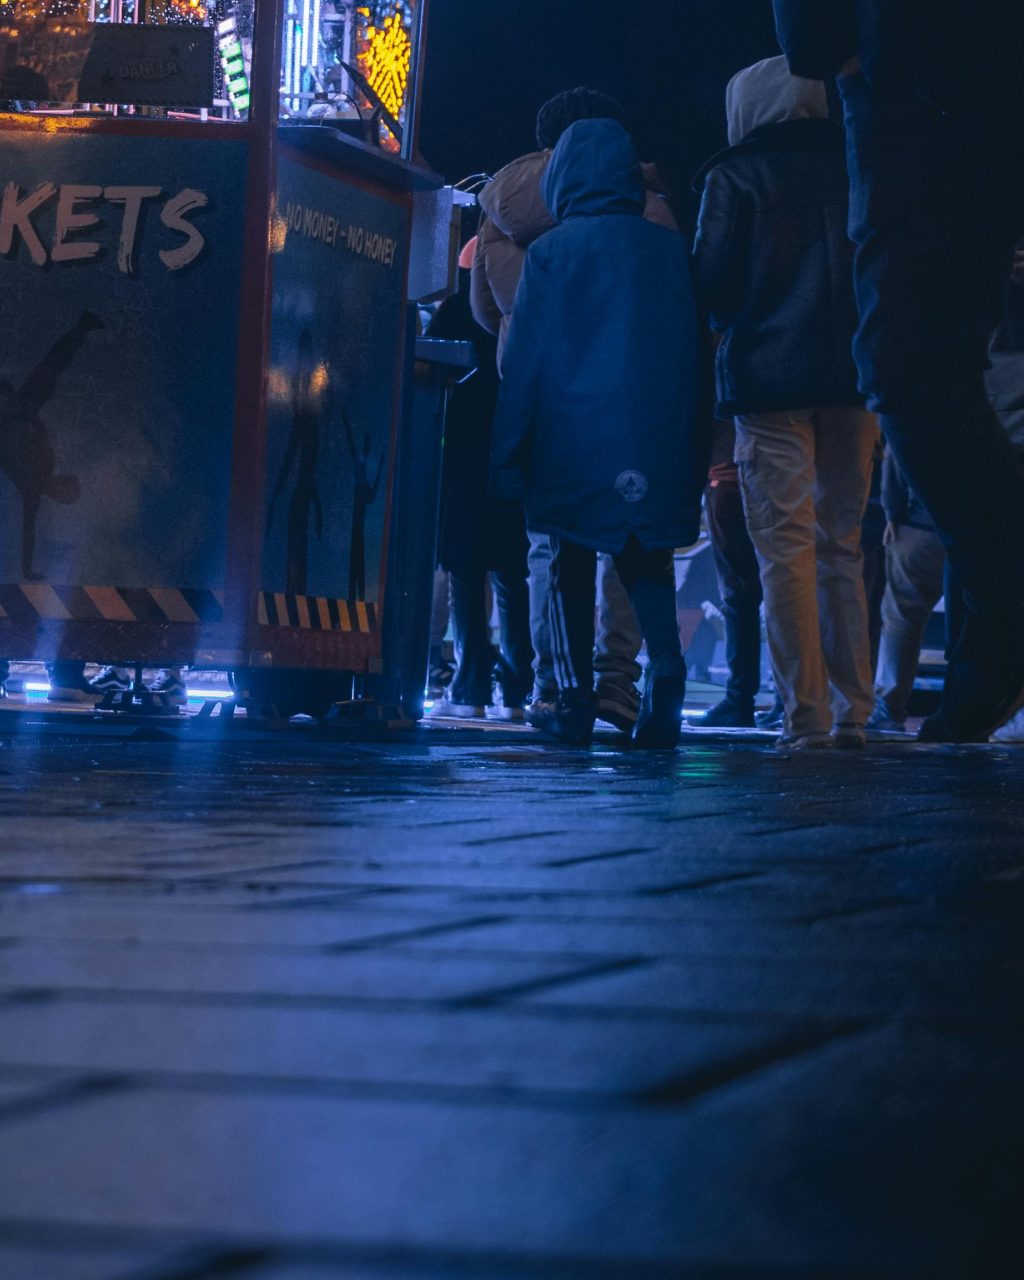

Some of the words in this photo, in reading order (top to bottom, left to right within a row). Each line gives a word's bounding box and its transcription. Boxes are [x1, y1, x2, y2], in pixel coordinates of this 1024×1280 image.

[303, 207, 340, 247] MONEY
[347, 225, 363, 255] NO
[364, 231, 397, 267] HONEY
